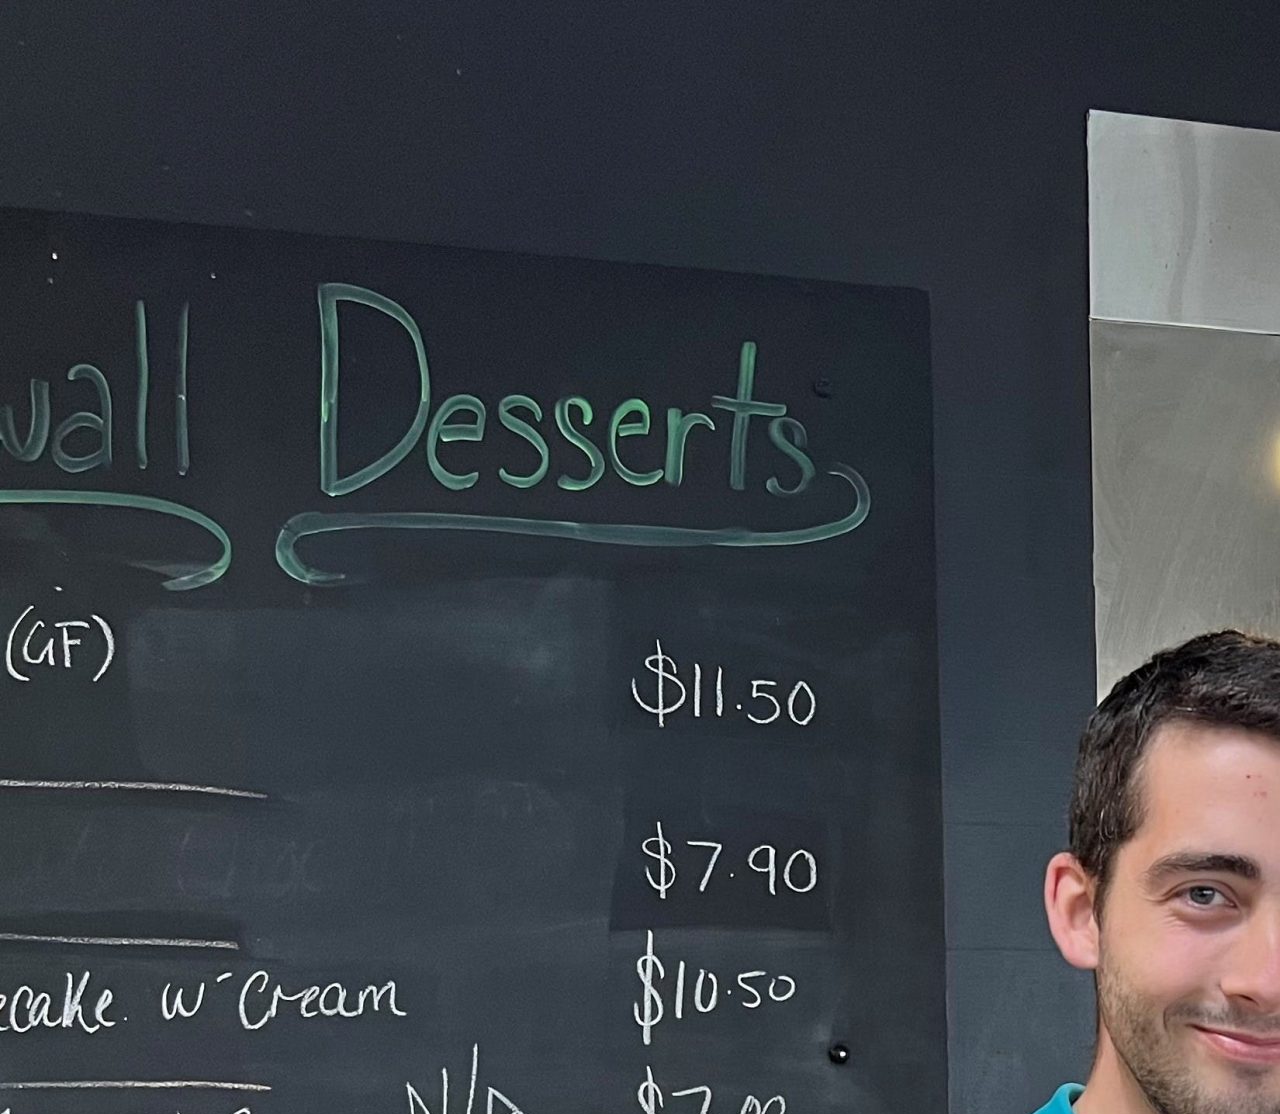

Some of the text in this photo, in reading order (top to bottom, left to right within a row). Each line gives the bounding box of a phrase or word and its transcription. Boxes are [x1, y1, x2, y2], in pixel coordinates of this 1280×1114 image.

[318, 281, 817, 498] Desserts
[5, 605, 115, 683] (GF)
[631, 639, 817, 728] $11.50
[641, 821, 818, 900] $7.90
[238, 969, 408, 1031] Cream
[633, 929, 797, 1046] $10.50
